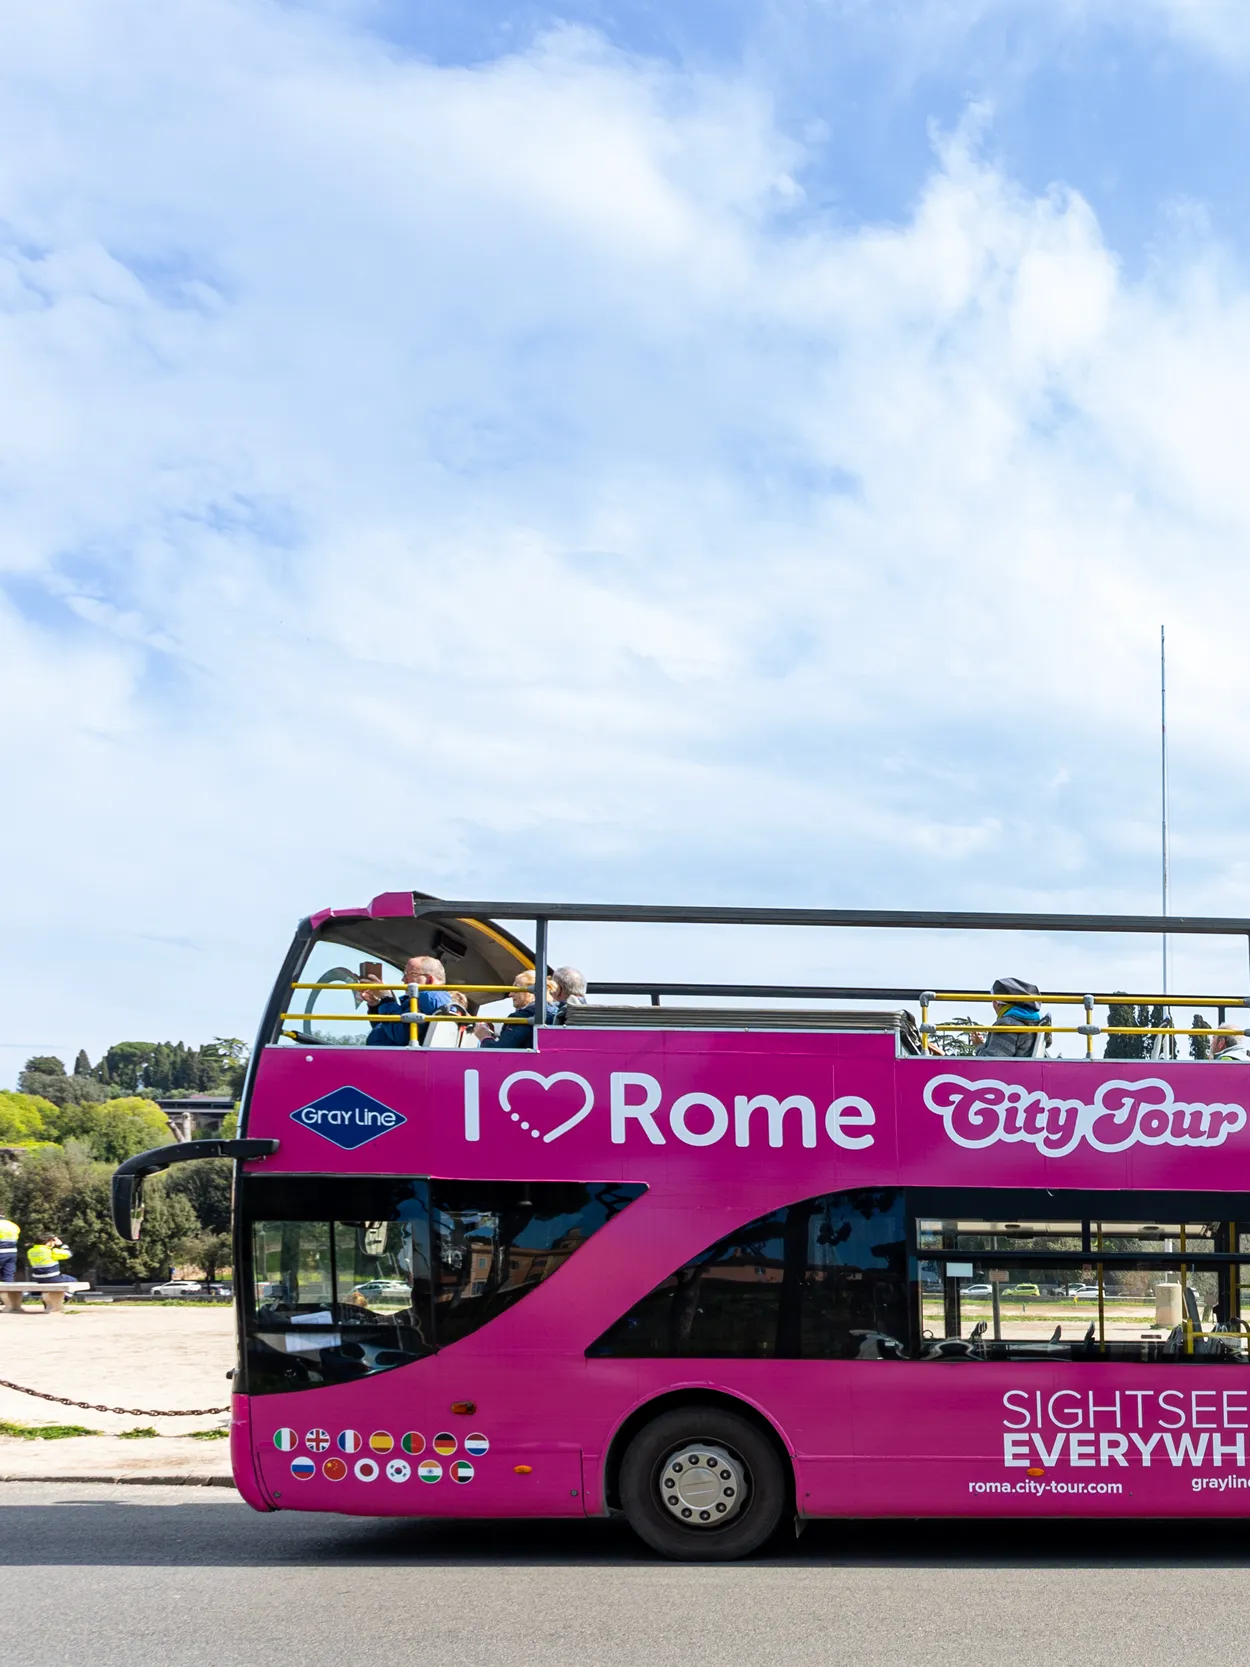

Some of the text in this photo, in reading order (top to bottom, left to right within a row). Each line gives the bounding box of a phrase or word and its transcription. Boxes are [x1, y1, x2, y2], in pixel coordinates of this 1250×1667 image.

[301, 1107, 396, 1127] Gray Line
[464, 1069, 876, 1150] I Rome
[928, 1077, 1243, 1153] City Tour
[968, 1478, 1123, 1497] roma.city-tour.com
